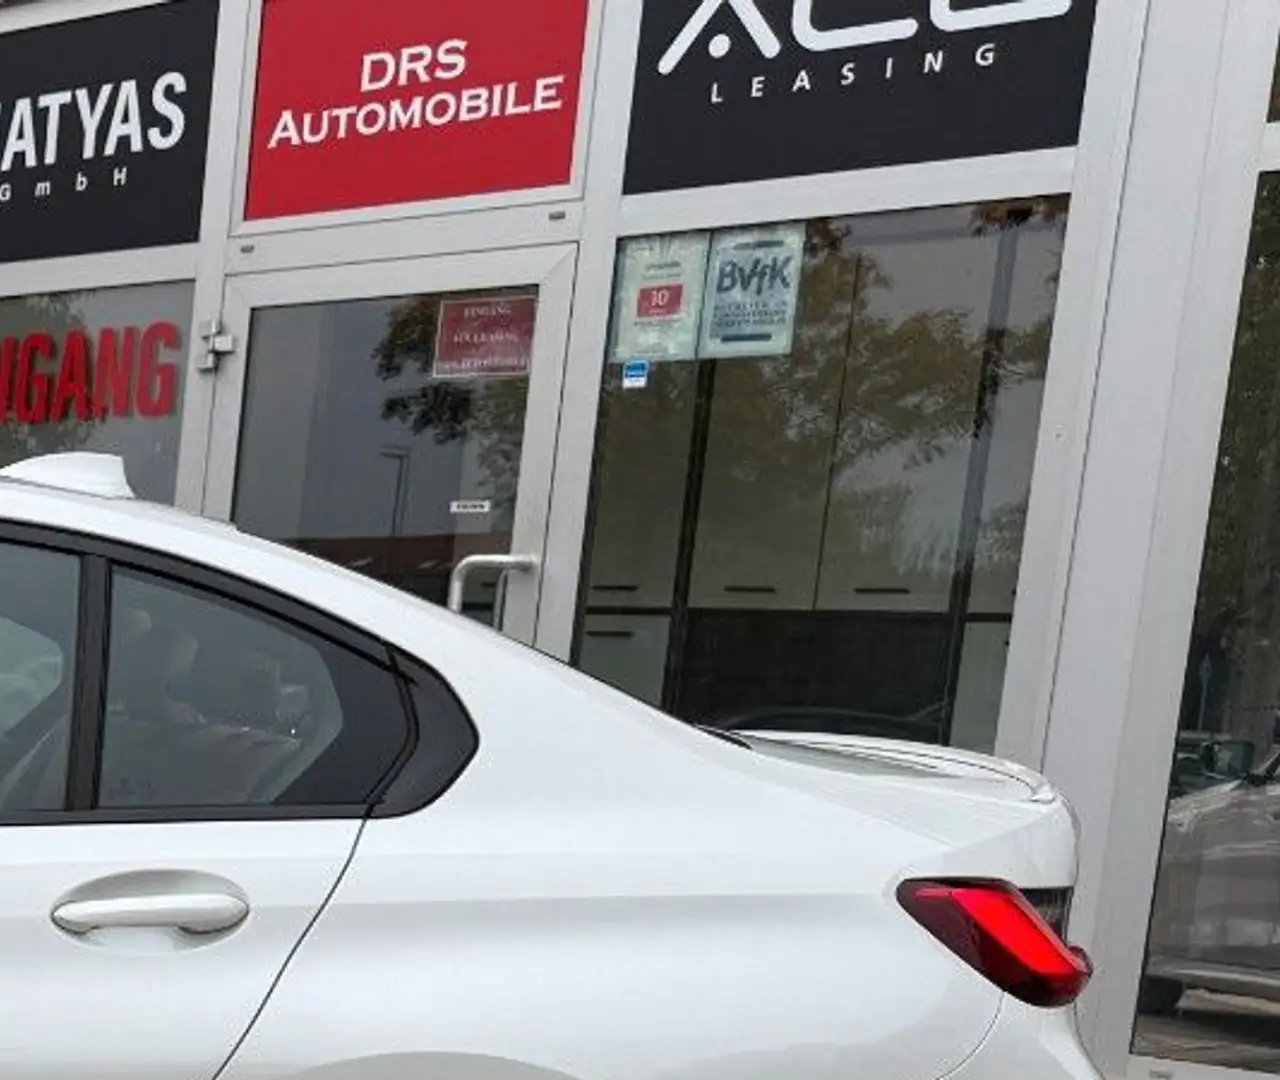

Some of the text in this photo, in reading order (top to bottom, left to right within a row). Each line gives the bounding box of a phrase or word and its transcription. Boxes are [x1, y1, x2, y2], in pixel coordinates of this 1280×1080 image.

[360, 38, 468, 93] DRS
[710, 43, 996, 103] LEASING
[267, 75, 566, 149] AUTOMOBILE
